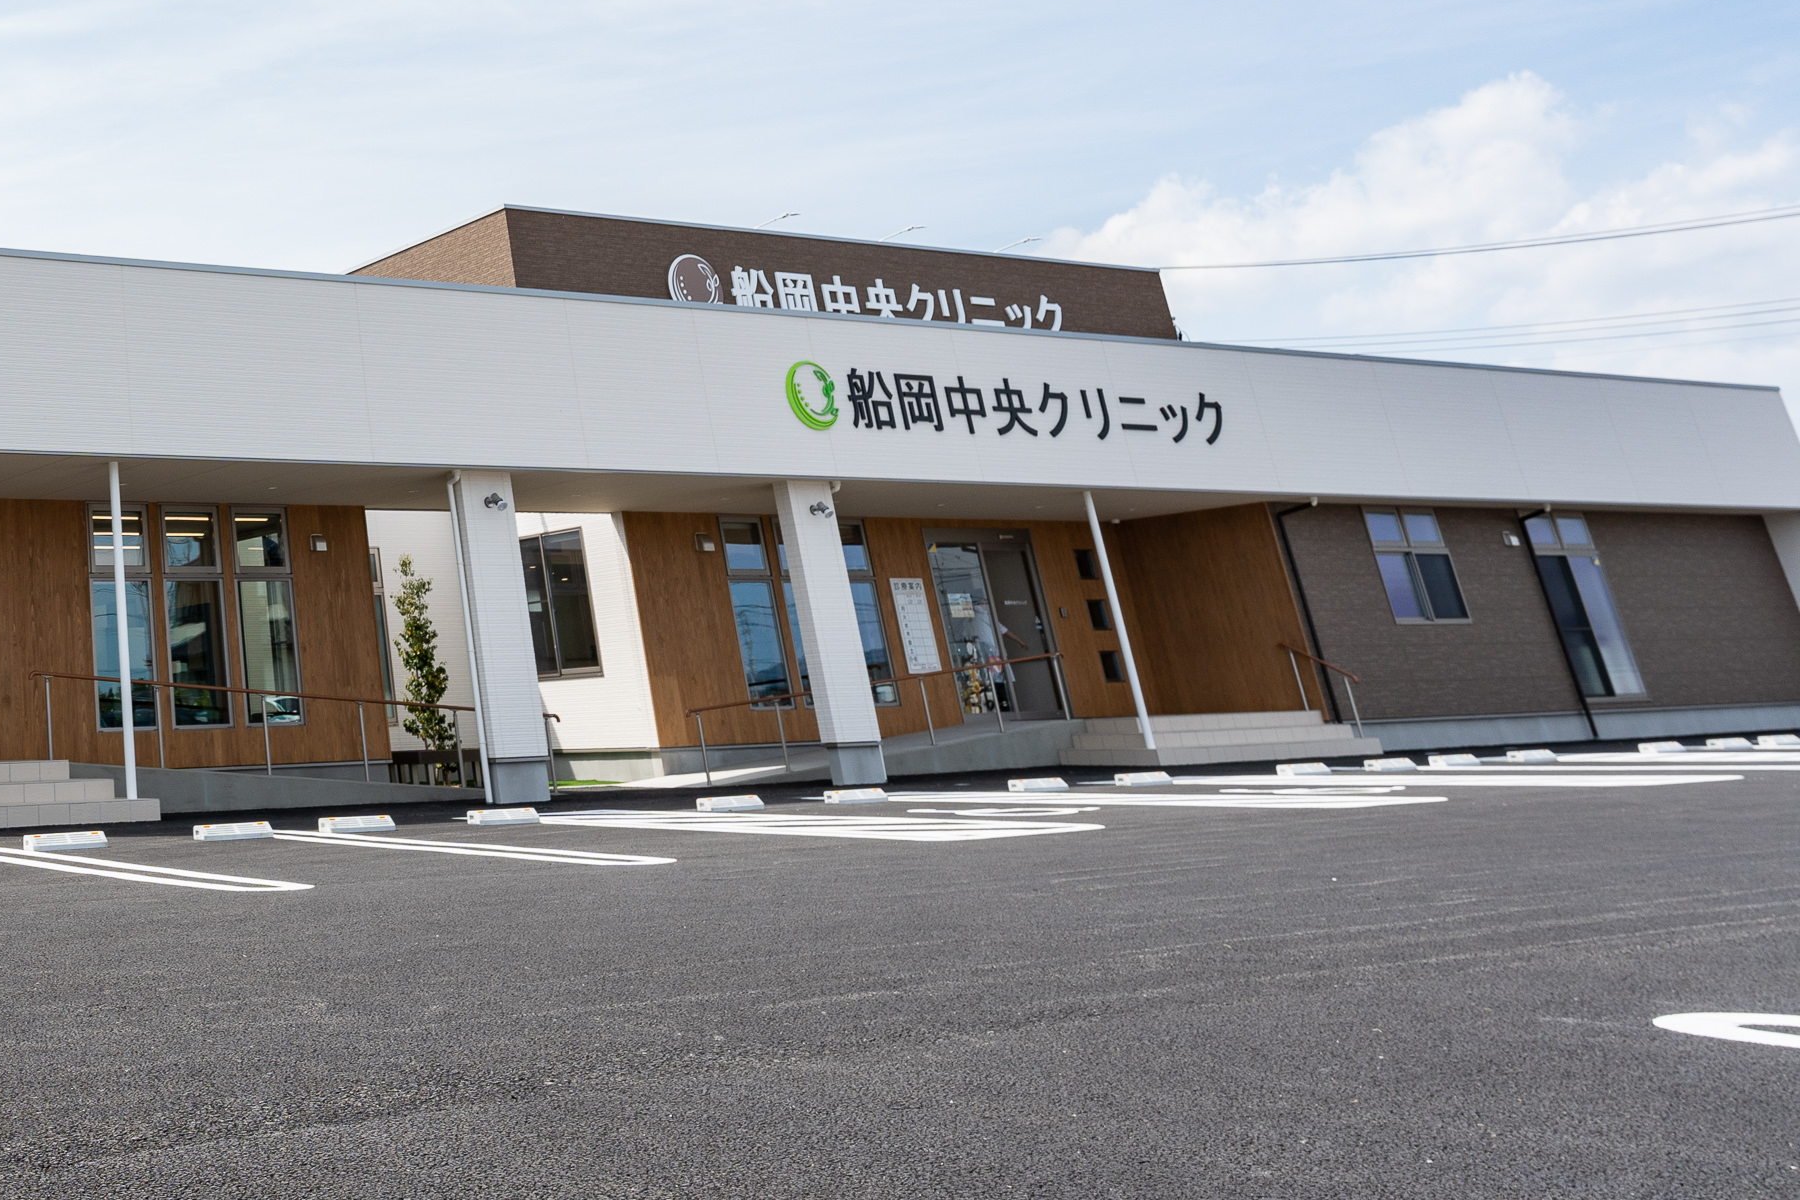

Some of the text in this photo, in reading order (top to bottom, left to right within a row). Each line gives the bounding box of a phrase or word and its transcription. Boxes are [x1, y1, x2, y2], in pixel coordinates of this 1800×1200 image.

[730, 265, 1063, 333] 船岡中央クリニック
[847, 368, 1222, 445] 船岡中央クリニック
